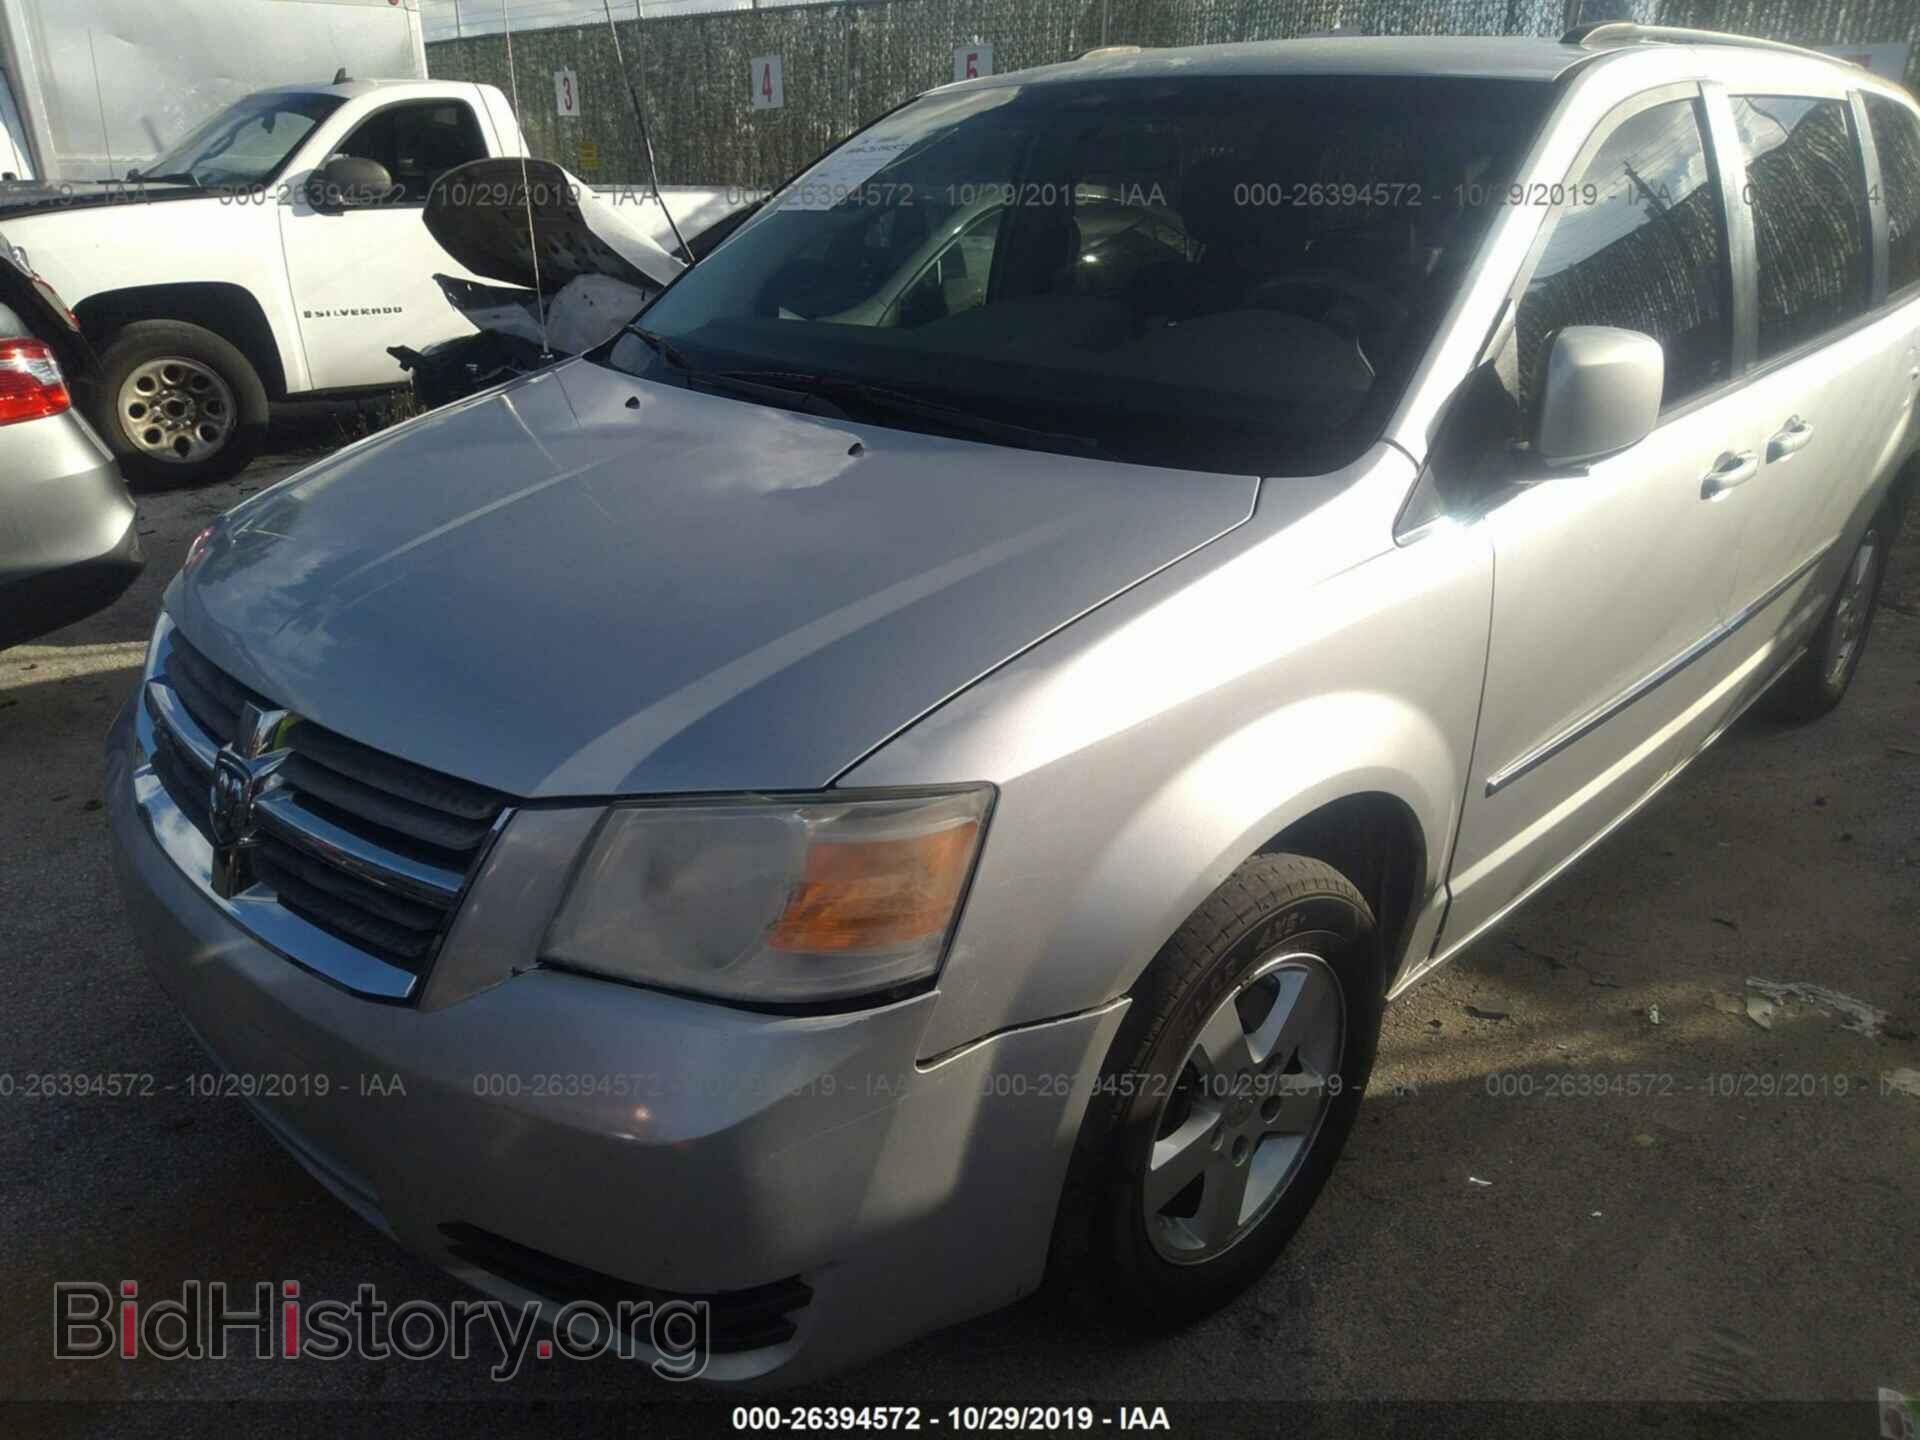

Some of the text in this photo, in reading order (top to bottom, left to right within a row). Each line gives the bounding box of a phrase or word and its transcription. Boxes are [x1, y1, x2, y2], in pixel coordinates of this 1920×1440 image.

[966, 53, 978, 78] 5
[562, 77, 573, 112] 3
[762, 64, 773, 103] 4
[314, 306, 402, 318] SILVERADO
